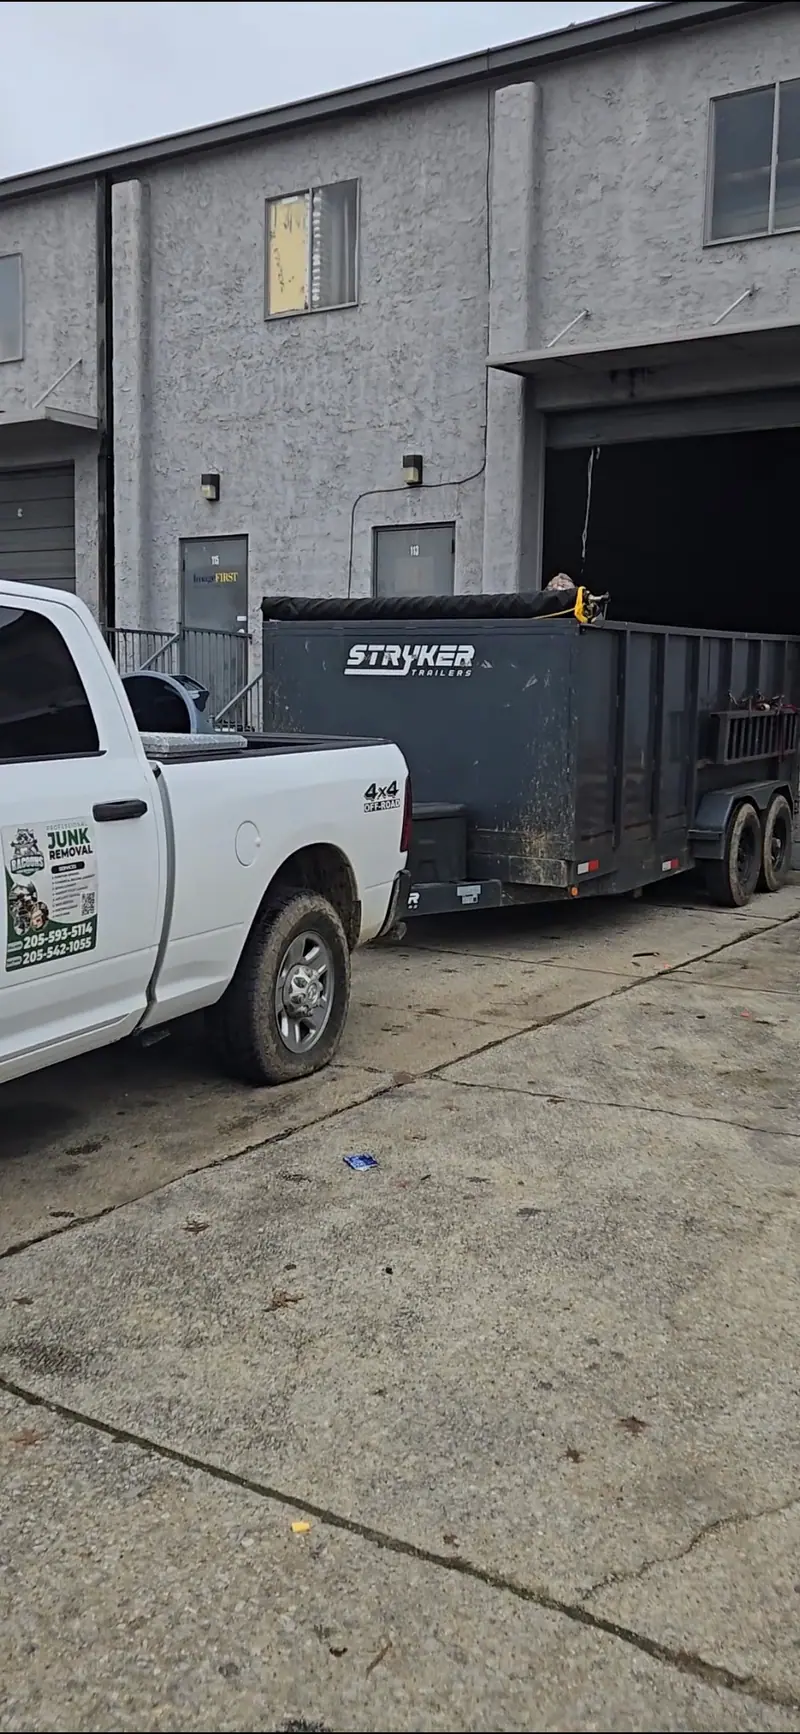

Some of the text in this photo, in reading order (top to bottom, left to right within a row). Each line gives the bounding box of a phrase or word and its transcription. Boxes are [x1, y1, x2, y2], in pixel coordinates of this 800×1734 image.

[344, 644, 475, 676] STRYKER
[411, 669, 472, 677] TRAILERS
[364, 780, 399, 801] 4x4
[364, 799, 400, 812] OFF-ROAD
[47, 827, 91, 849] JUNK
[49, 845, 93, 860] REMOVAL
[23, 922, 93, 949] 205-593-5114
[22, 936, 92, 964] 205-542-1055
